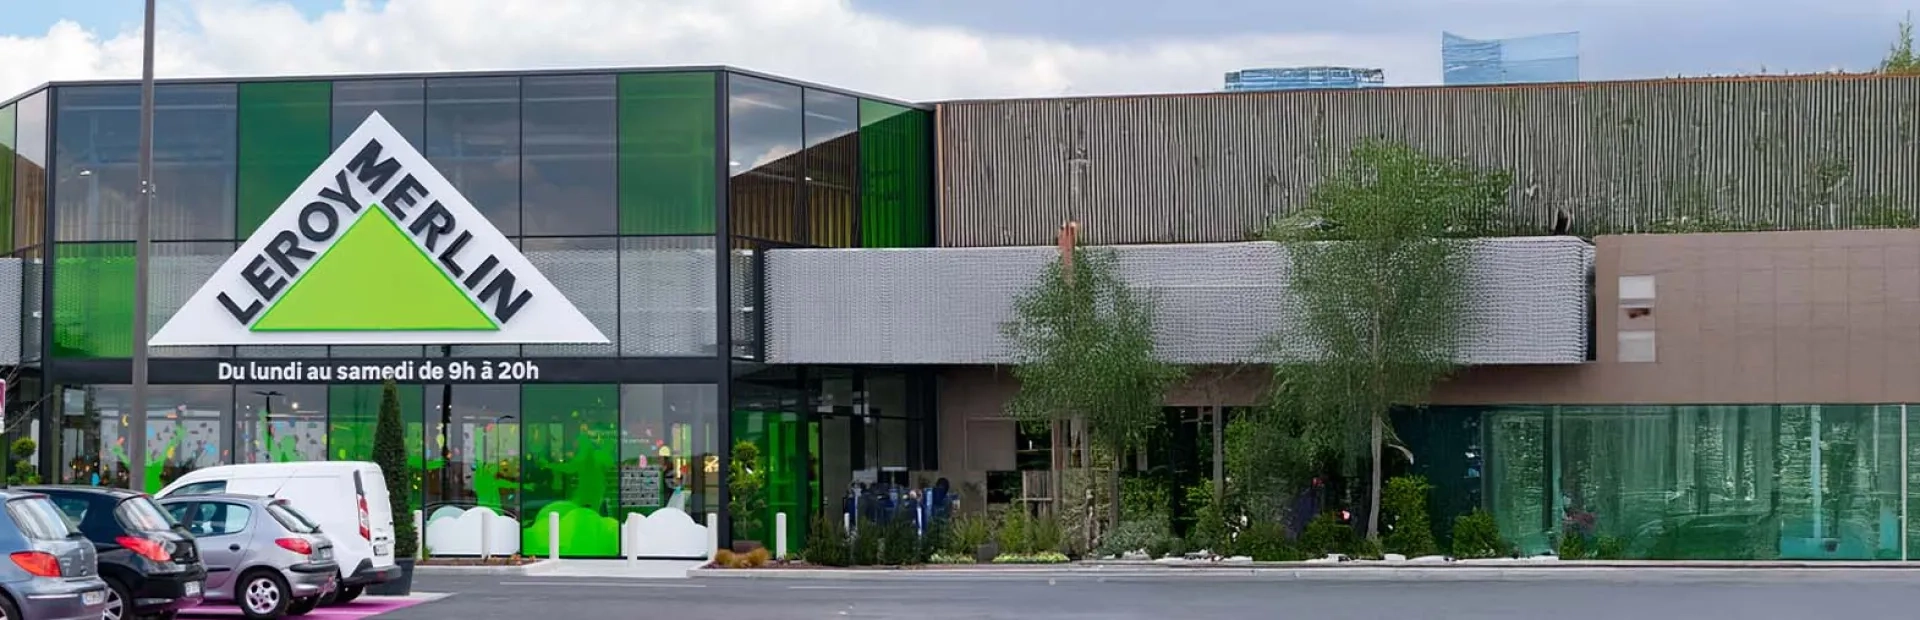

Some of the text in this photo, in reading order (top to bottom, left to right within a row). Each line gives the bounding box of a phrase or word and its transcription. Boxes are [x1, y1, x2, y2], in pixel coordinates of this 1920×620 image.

[216, 137, 533, 326] LEROY MERLIN
[218, 362, 246, 381] Du
[250, 361, 302, 381] lundi
[306, 365, 332, 381] au
[336, 360, 414, 381] samedi
[418, 360, 444, 381] de
[448, 360, 476, 381] 9h
[498, 360, 540, 381] 20h
